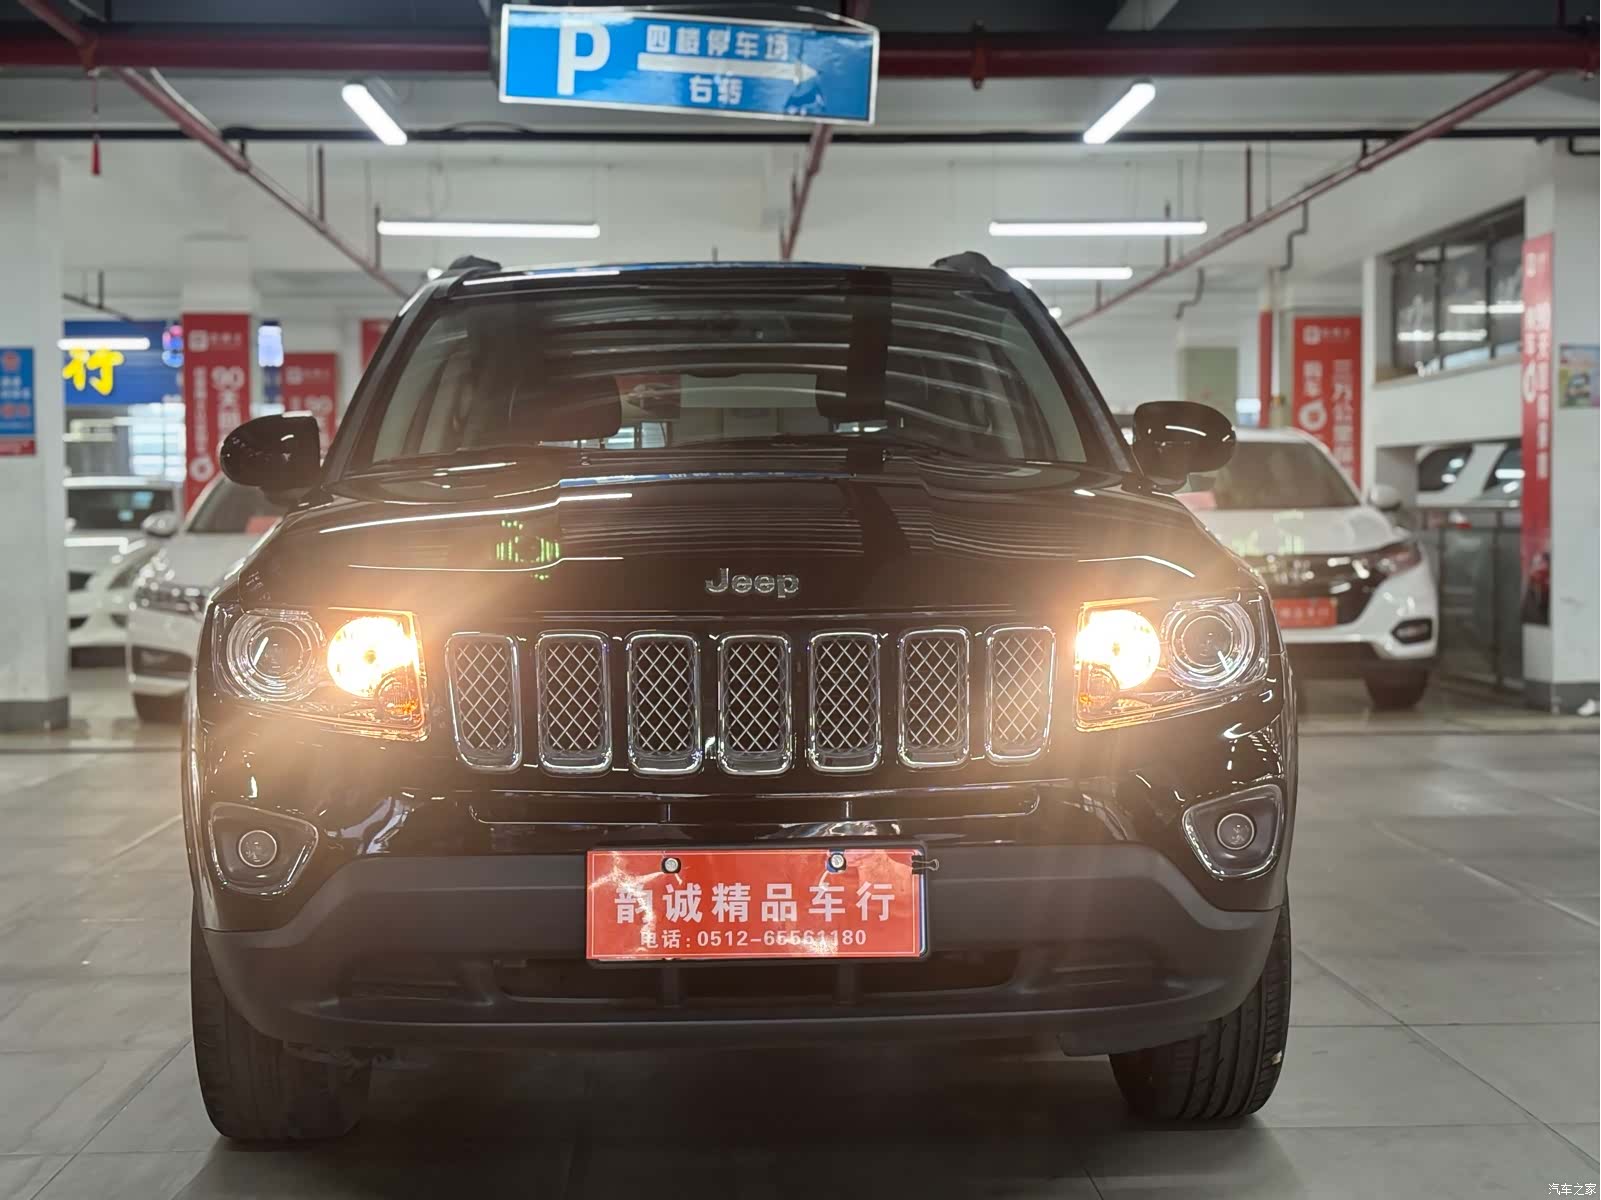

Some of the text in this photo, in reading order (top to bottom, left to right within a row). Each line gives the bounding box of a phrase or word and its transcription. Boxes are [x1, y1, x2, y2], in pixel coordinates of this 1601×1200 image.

[556, 21, 611, 96] P
[688, 76, 744, 105] 右转
[705, 567, 800, 599] Jeep
